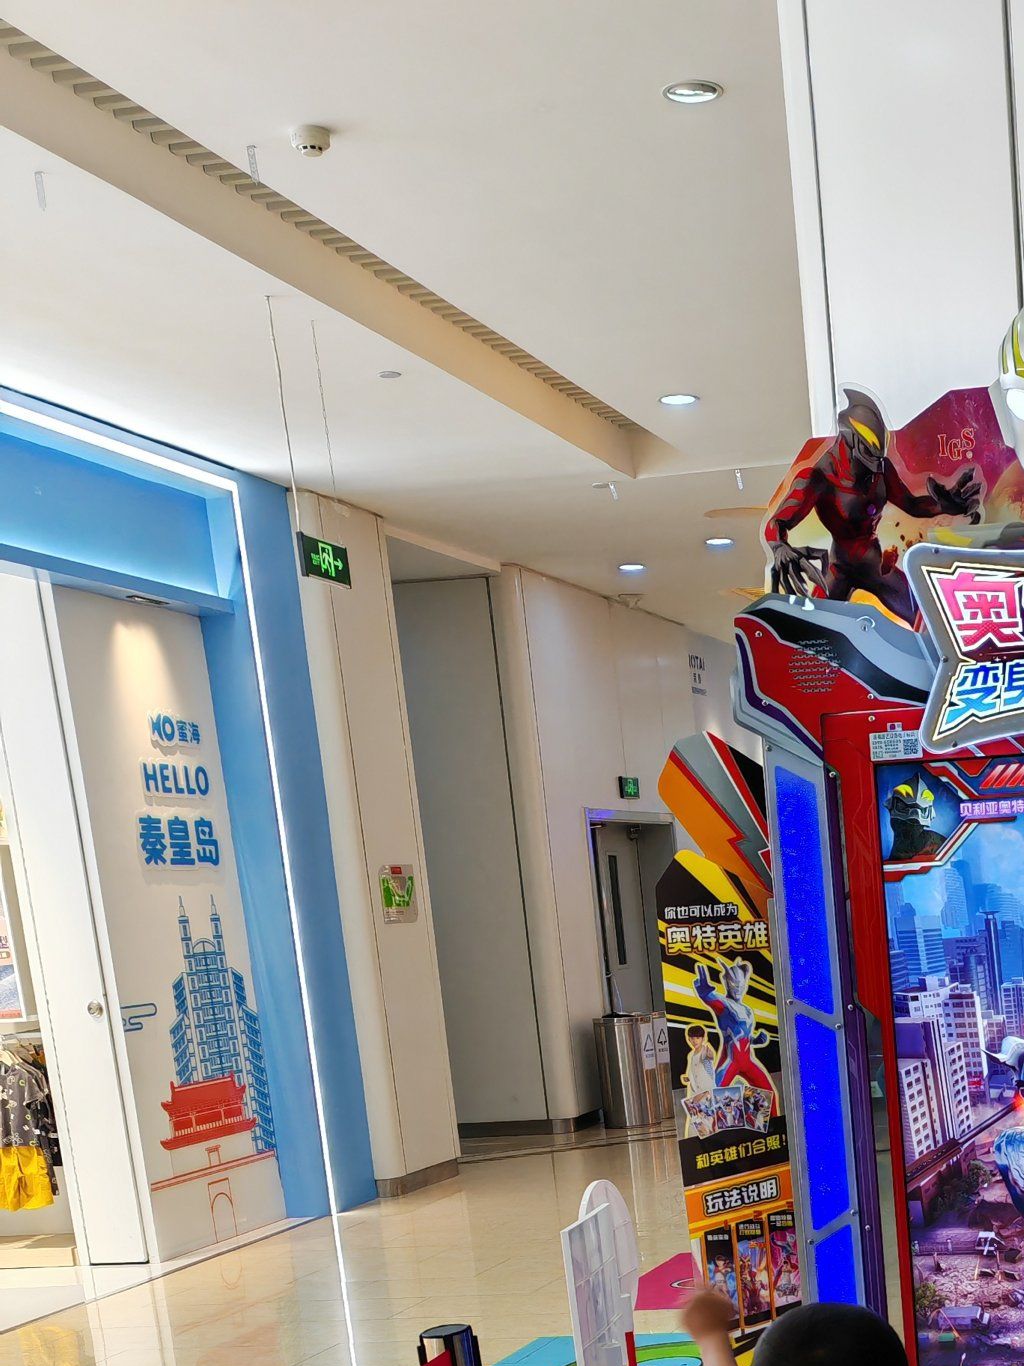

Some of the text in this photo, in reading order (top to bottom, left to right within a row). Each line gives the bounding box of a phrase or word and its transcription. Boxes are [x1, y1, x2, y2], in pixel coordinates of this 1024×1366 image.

[937, 428, 976, 460] IGS
[143, 763, 209, 796] HELLO
[138, 815, 220, 866] 秦皇岛
[664, 902, 738, 920] 你也可以成为
[666, 921, 769, 953] 奥特英雄
[705, 1178, 778, 1213] 玩法说明
